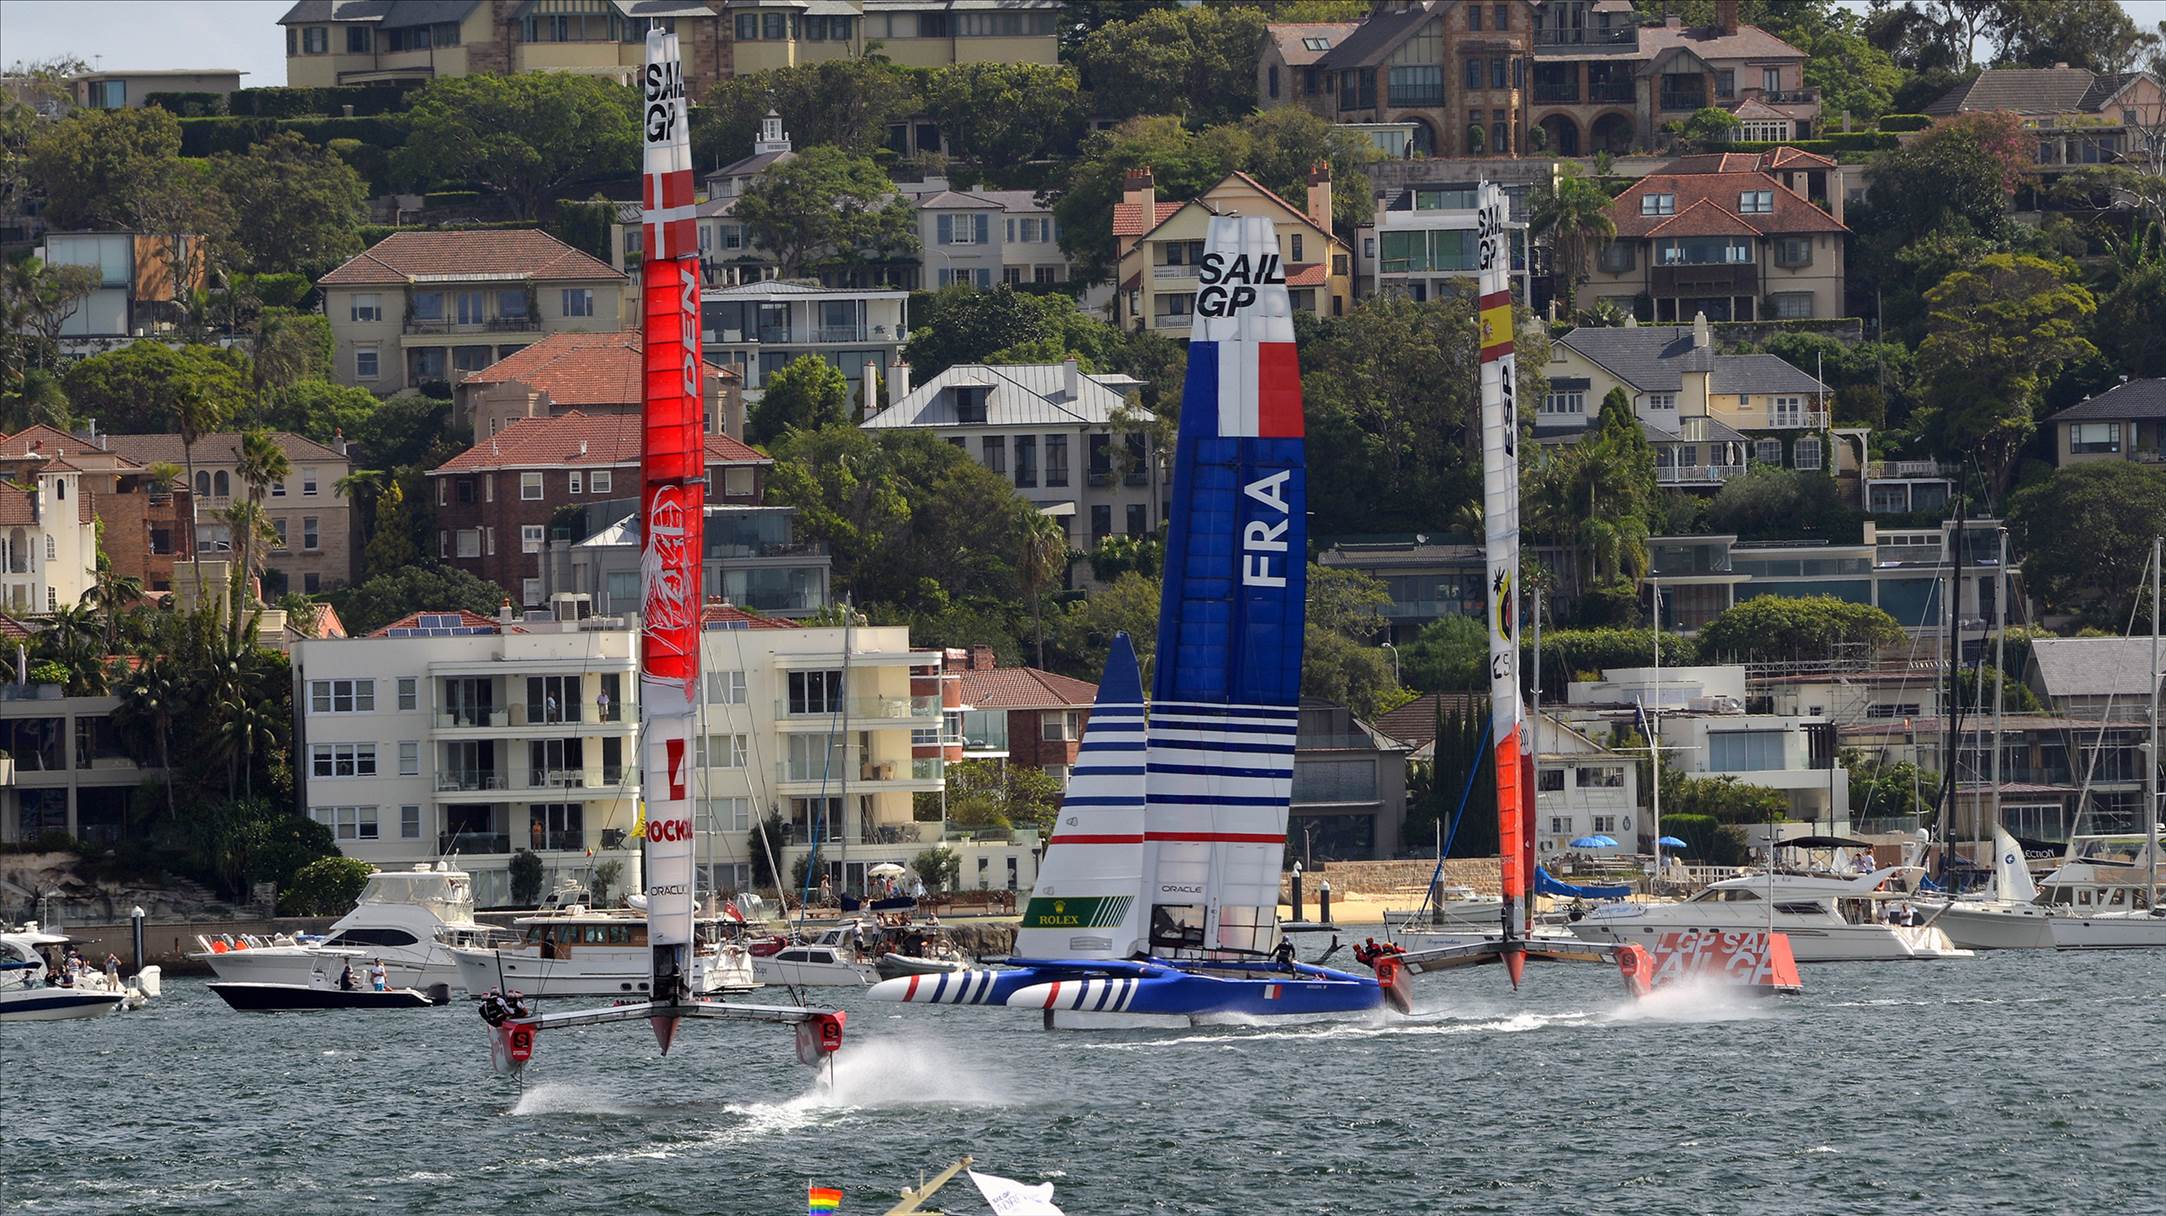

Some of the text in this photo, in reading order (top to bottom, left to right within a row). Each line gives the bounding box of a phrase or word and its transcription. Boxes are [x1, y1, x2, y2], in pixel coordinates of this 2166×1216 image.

[646, 61, 685, 102] SAIL
[646, 104, 676, 142] GP
[1478, 205, 1503, 239] SAIL
[1199, 253, 1286, 285] SAIL
[1479, 239, 1497, 270] GP
[1197, 286, 1256, 317] GP
[680, 268, 697, 398] DEN
[1502, 365, 1514, 457] ESP
[1242, 469, 1290, 587] FRA
[1161, 885, 1203, 894] ORACLE
[1040, 915, 1079, 925] ROLEX
